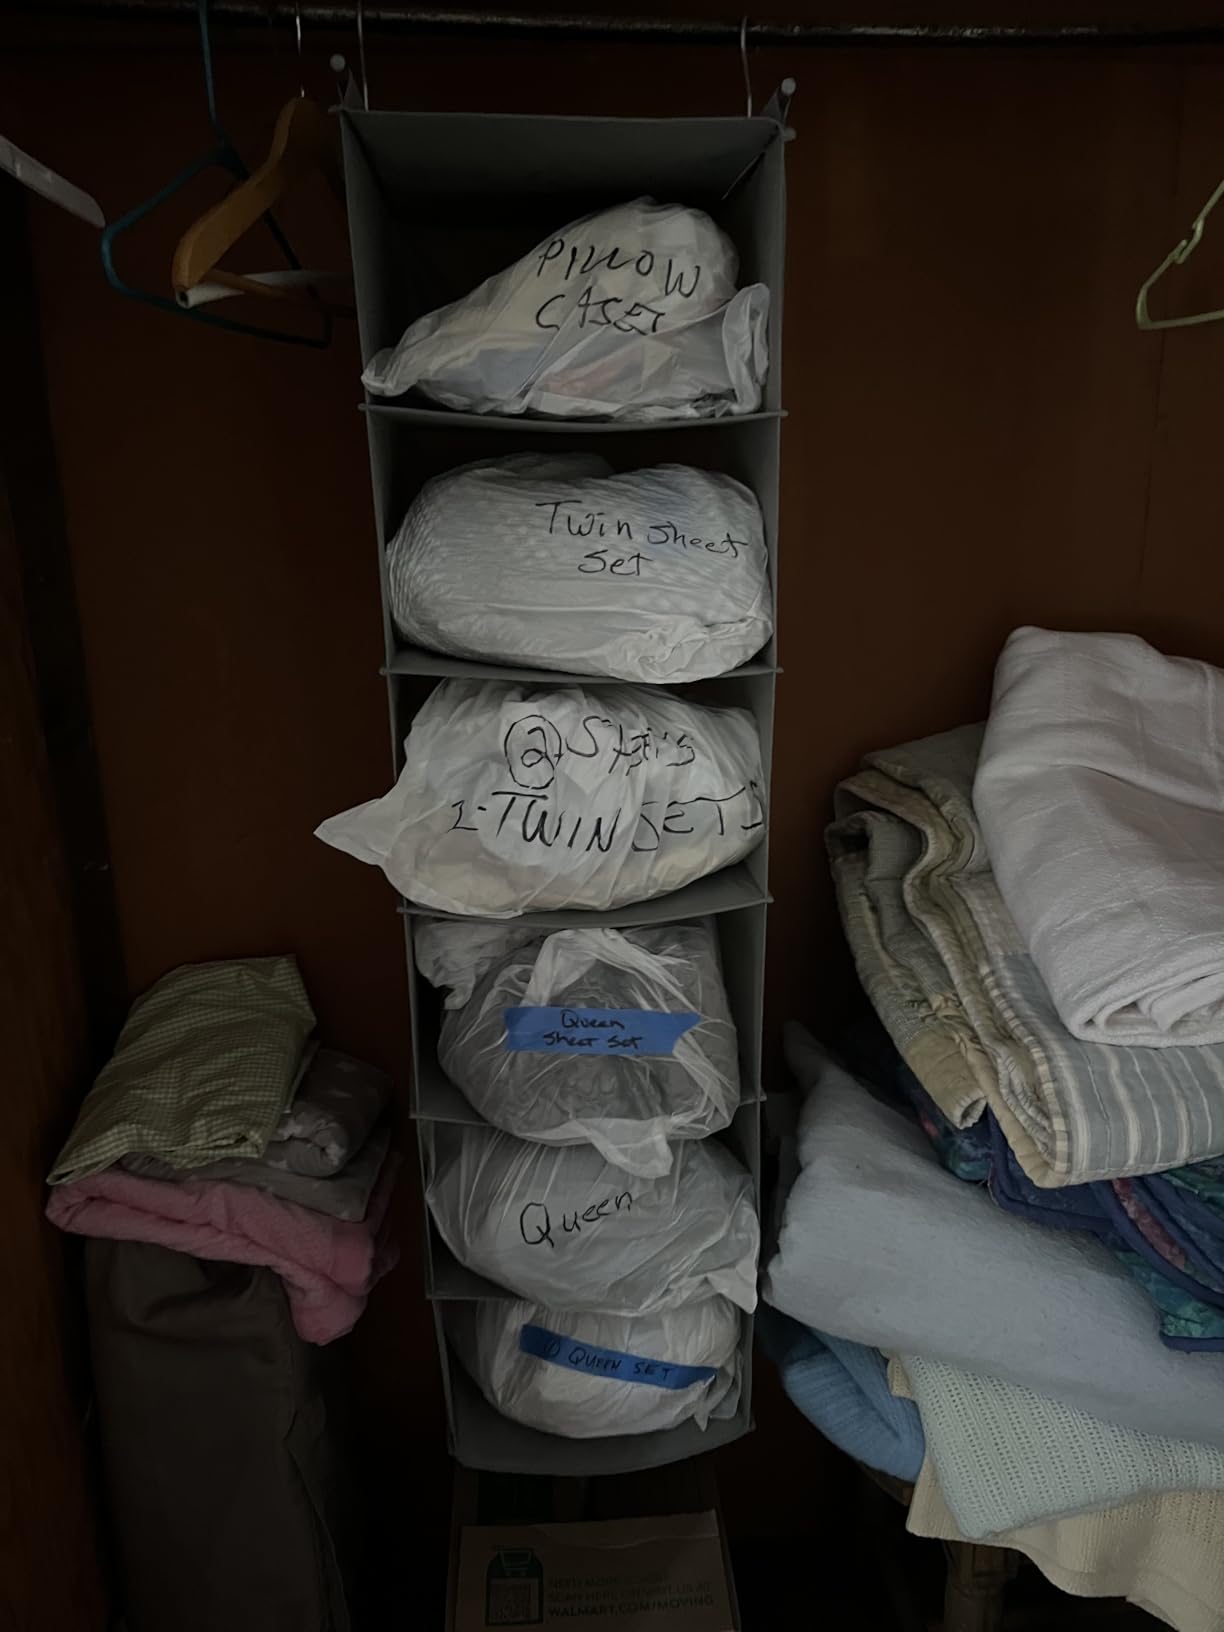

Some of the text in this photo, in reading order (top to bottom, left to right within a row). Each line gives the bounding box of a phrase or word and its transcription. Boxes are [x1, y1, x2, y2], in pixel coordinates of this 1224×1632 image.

[536, 238, 701, 298] PILLOW
[535, 500, 633, 540] Twin
[578, 549, 653, 576] Set
[560, 1009, 625, 1030] Queen
[520, 1191, 633, 1249] Queen
[633, 1361, 673, 1380] SET
[548, 1593, 714, 1617] WALMART.COM/MOVING
